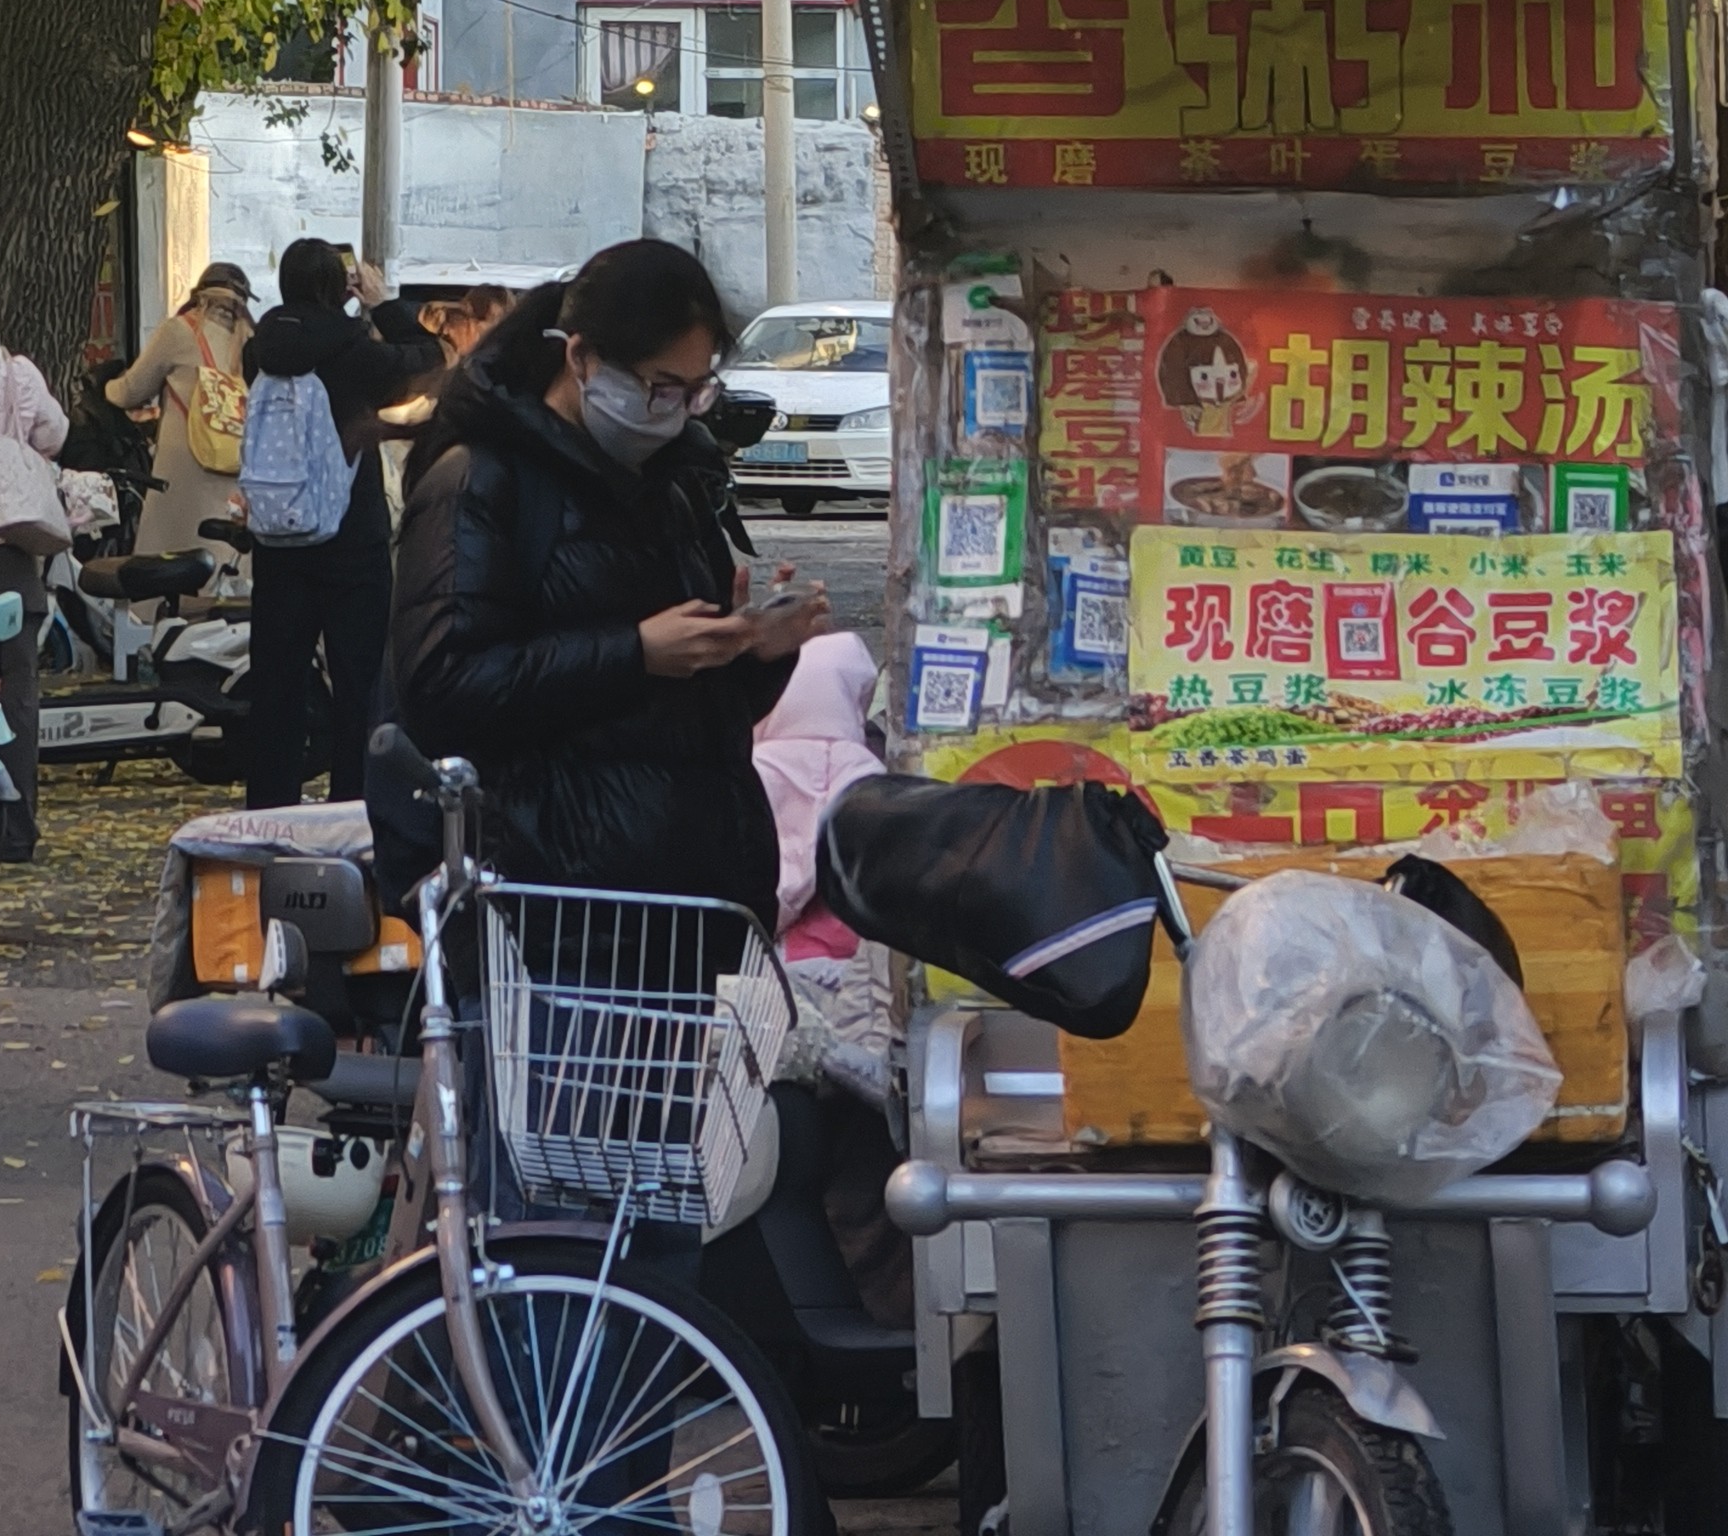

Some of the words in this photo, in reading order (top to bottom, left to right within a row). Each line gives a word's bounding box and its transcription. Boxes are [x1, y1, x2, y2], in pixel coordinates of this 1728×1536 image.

[1268, 332, 1647, 458] 胡辣汤
[1164, 579, 1638, 667] 现磨谷豆浆
[1169, 672, 1329, 710] 热豆浆
[1426, 672, 1643, 711] 冰冻豆浆
